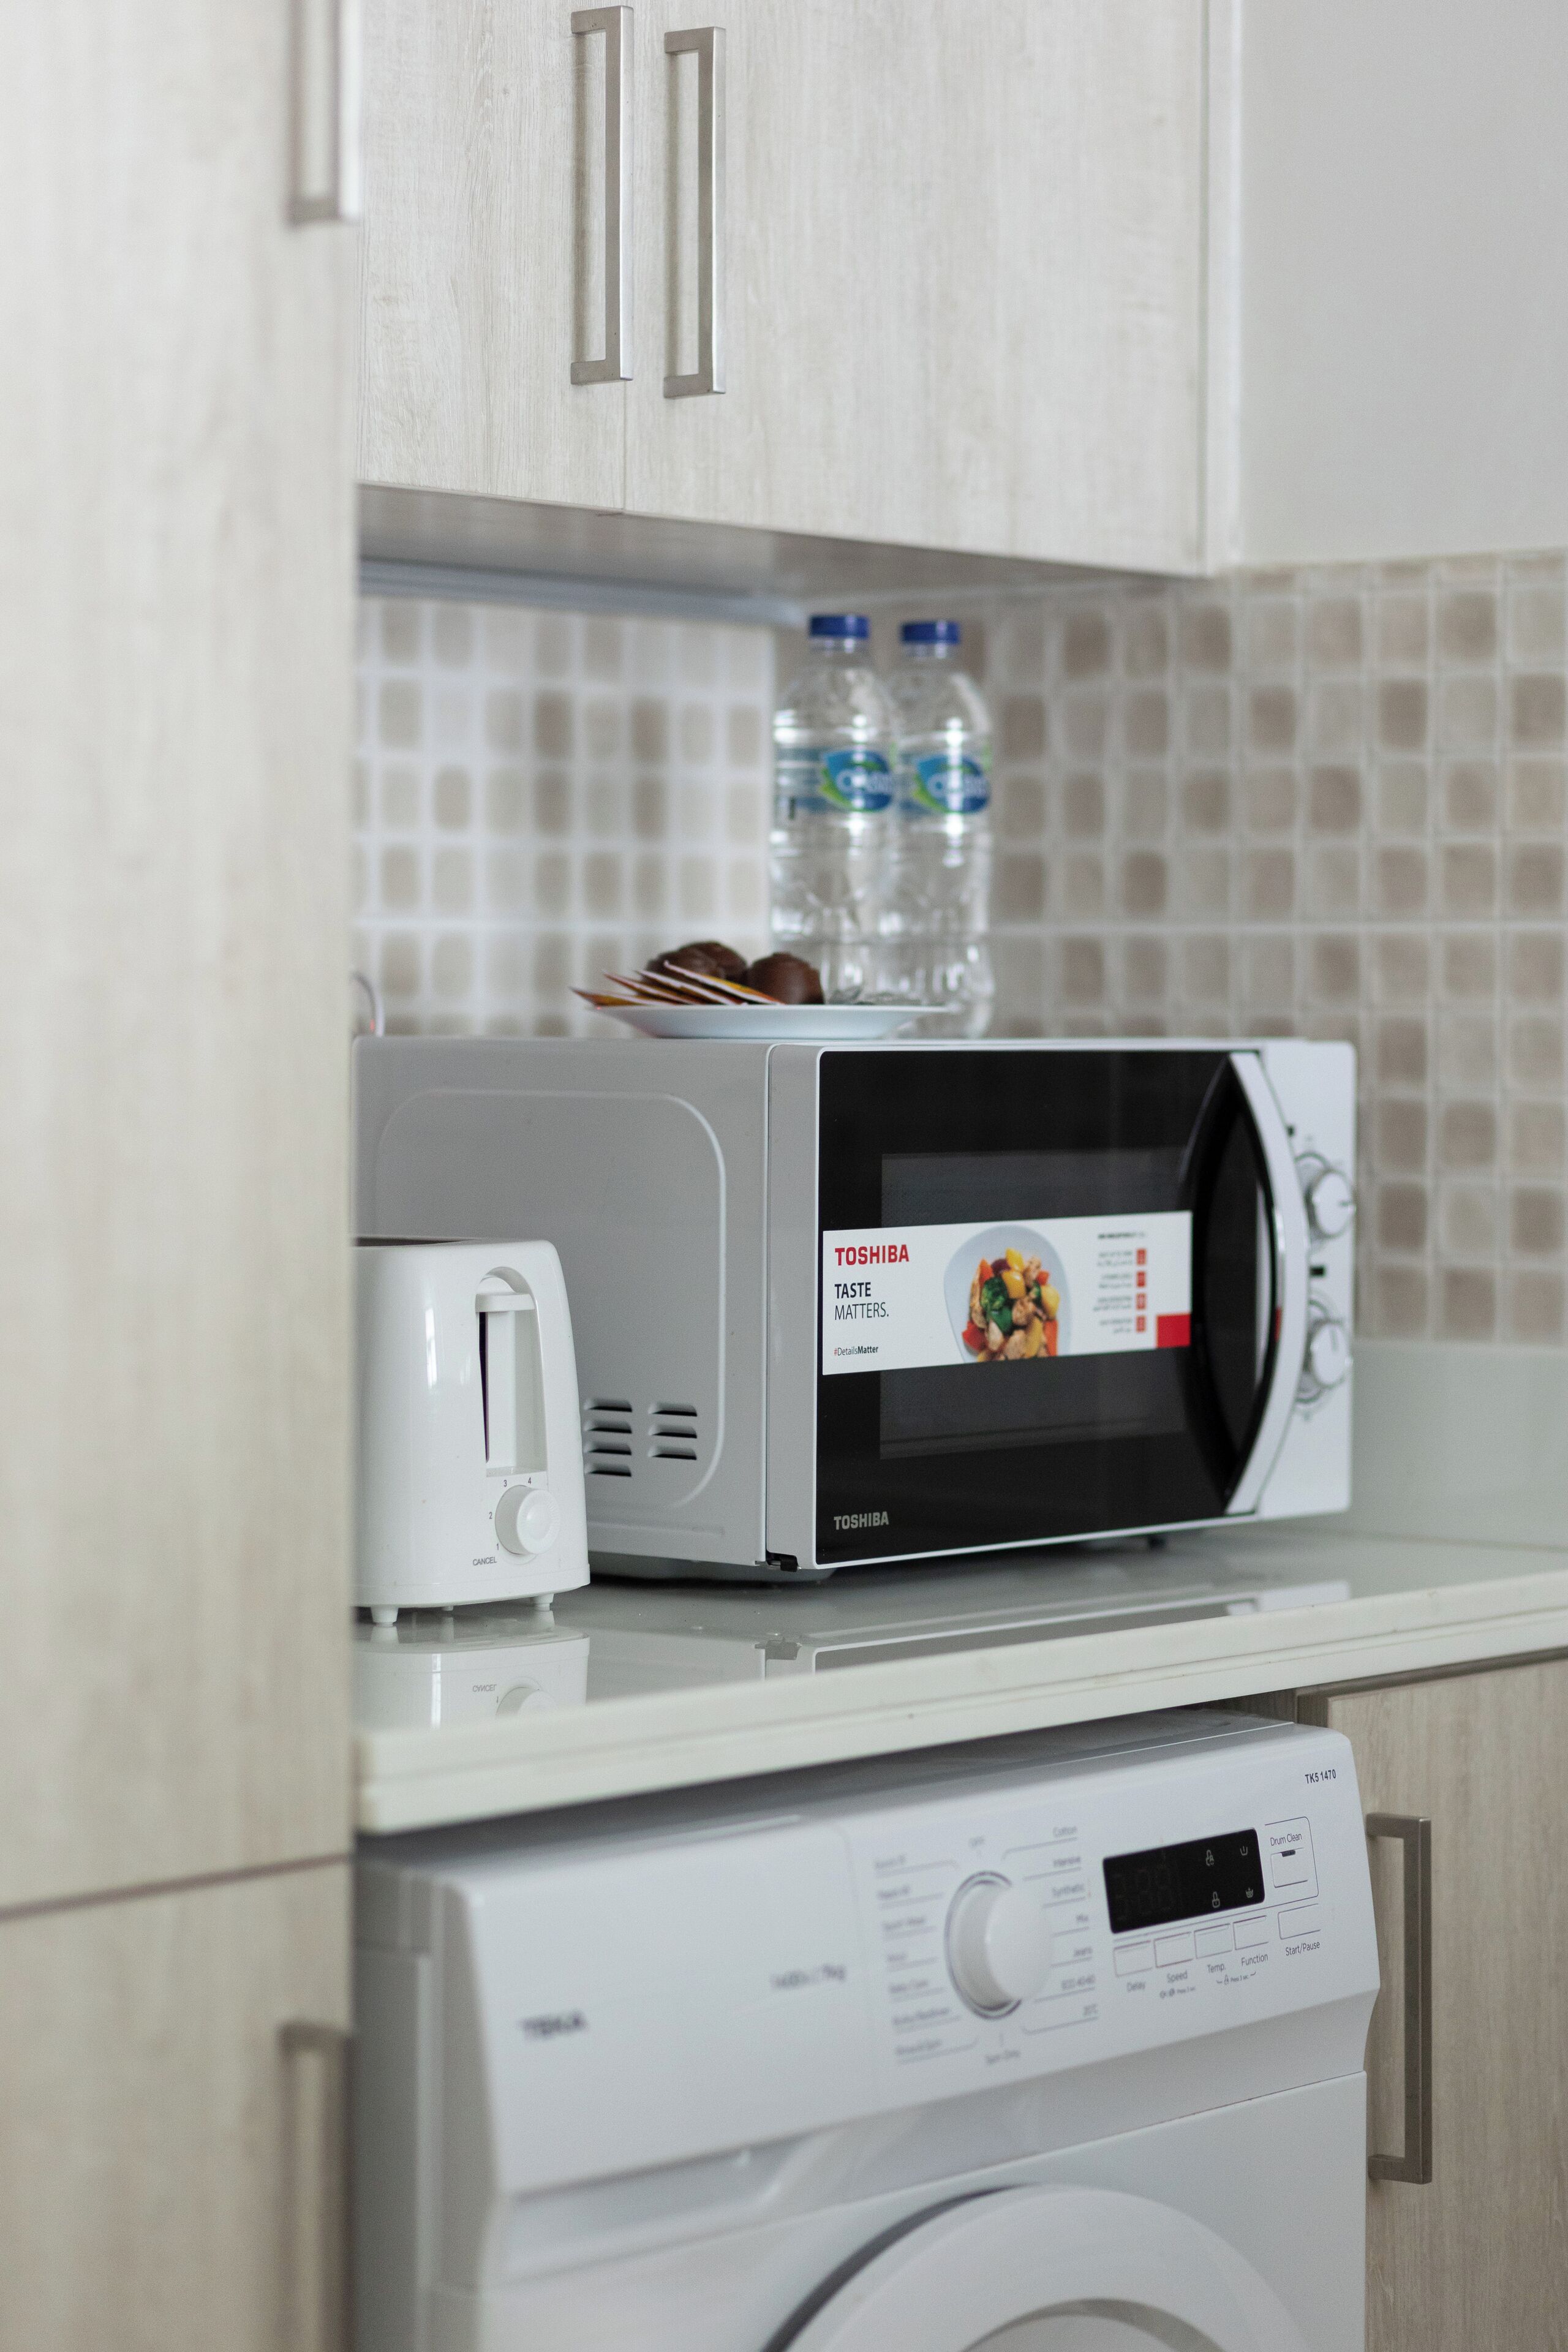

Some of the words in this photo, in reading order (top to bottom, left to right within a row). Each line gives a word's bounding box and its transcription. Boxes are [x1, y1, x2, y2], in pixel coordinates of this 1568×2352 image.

[834, 1244, 910, 1266] TOSHIBA
[834, 1281, 872, 1299] TASTE
[834, 1302, 889, 1321] MATTERS.
[834, 1345, 879, 1356] #DetailsMatter
[833, 1510, 889, 1530] TOSHIBA
[472, 1556, 497, 1566] CANCEL
[1305, 1772, 1319, 1784] TK5
[1320, 1769, 1336, 1781] 1470
[1270, 1836, 1287, 1846] Drum
[1286, 1833, 1302, 1843] Clean
[1285, 1941, 1321, 1956] Start/Pause
[1241, 1953, 1268, 1967] Function
[1207, 1963, 1226, 1973] Temp.
[1166, 1969, 1188, 1984] Speed
[1126, 1981, 1146, 1992] Delay
